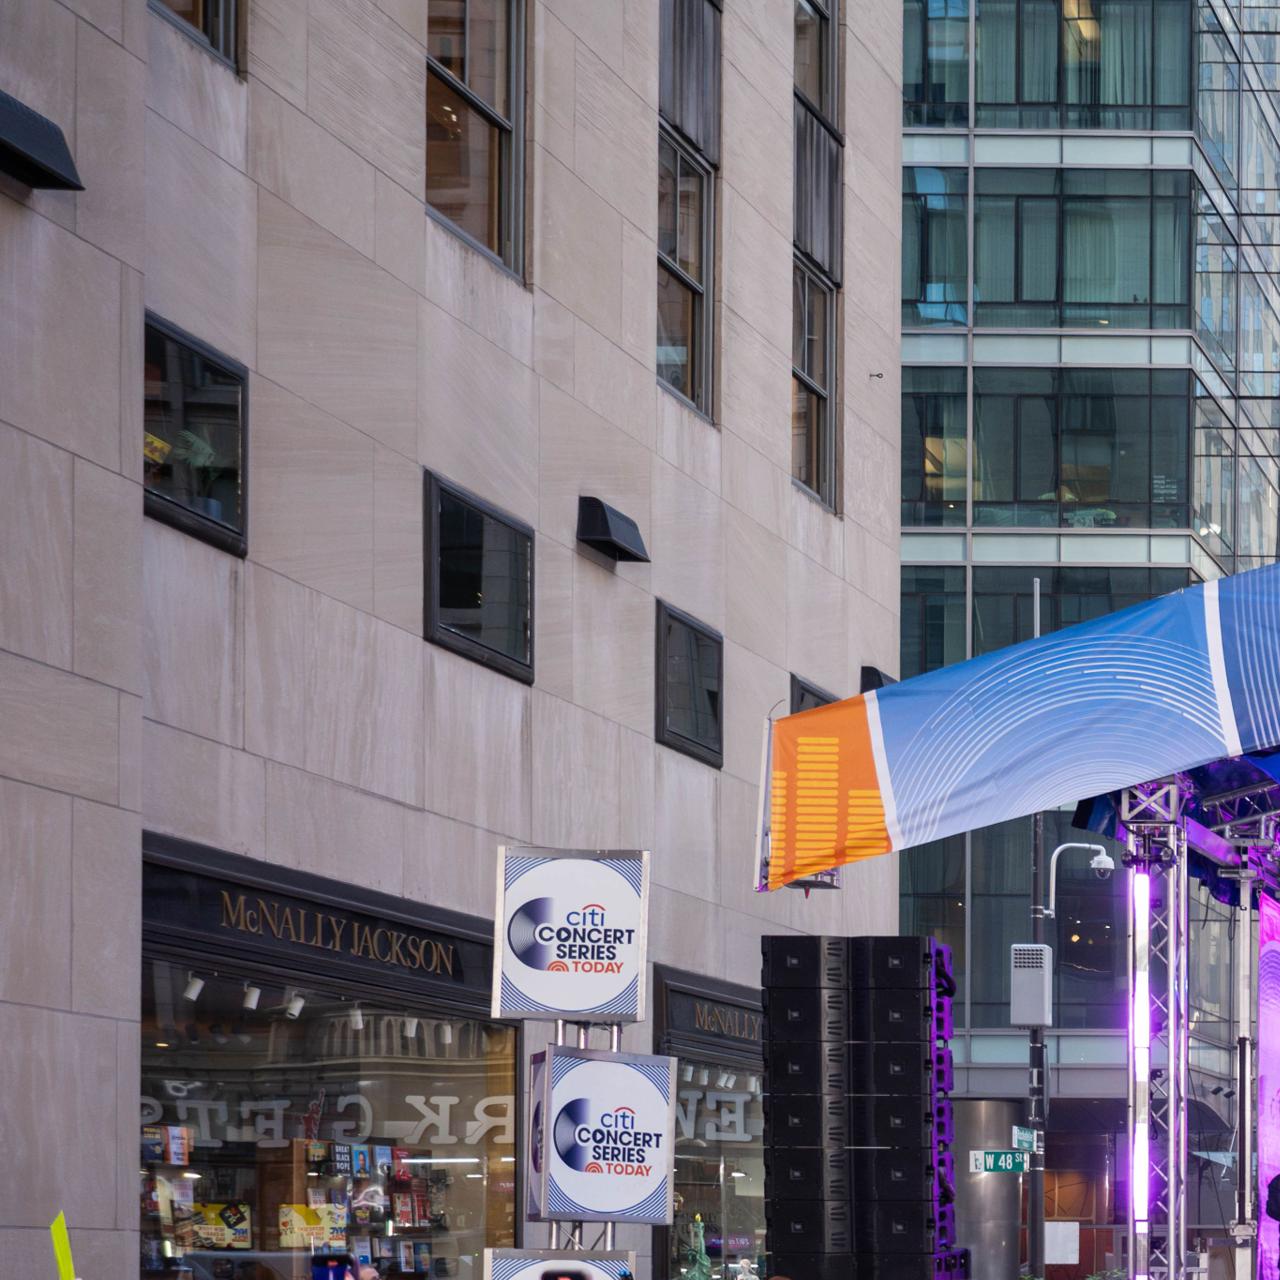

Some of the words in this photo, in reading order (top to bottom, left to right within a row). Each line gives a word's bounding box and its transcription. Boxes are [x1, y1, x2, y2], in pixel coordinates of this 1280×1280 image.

[566, 908, 605, 926] citi
[221, 890, 347, 951] McNALLY
[350, 922, 454, 976] JACKSON
[538, 927, 635, 944] CONCERT
[556, 944, 616, 960] SERIES
[572, 961, 624, 973] TODAY
[695, 1003, 760, 1040] McNALLY
[600, 1111, 634, 1129] citi
[577, 1127, 662, 1148] CONCERT
[592, 1145, 645, 1163] SERIES
[985, 1154, 995, 1169] W
[998, 1154, 1013, 1169] 48
[605, 1163, 652, 1176] TODAY
